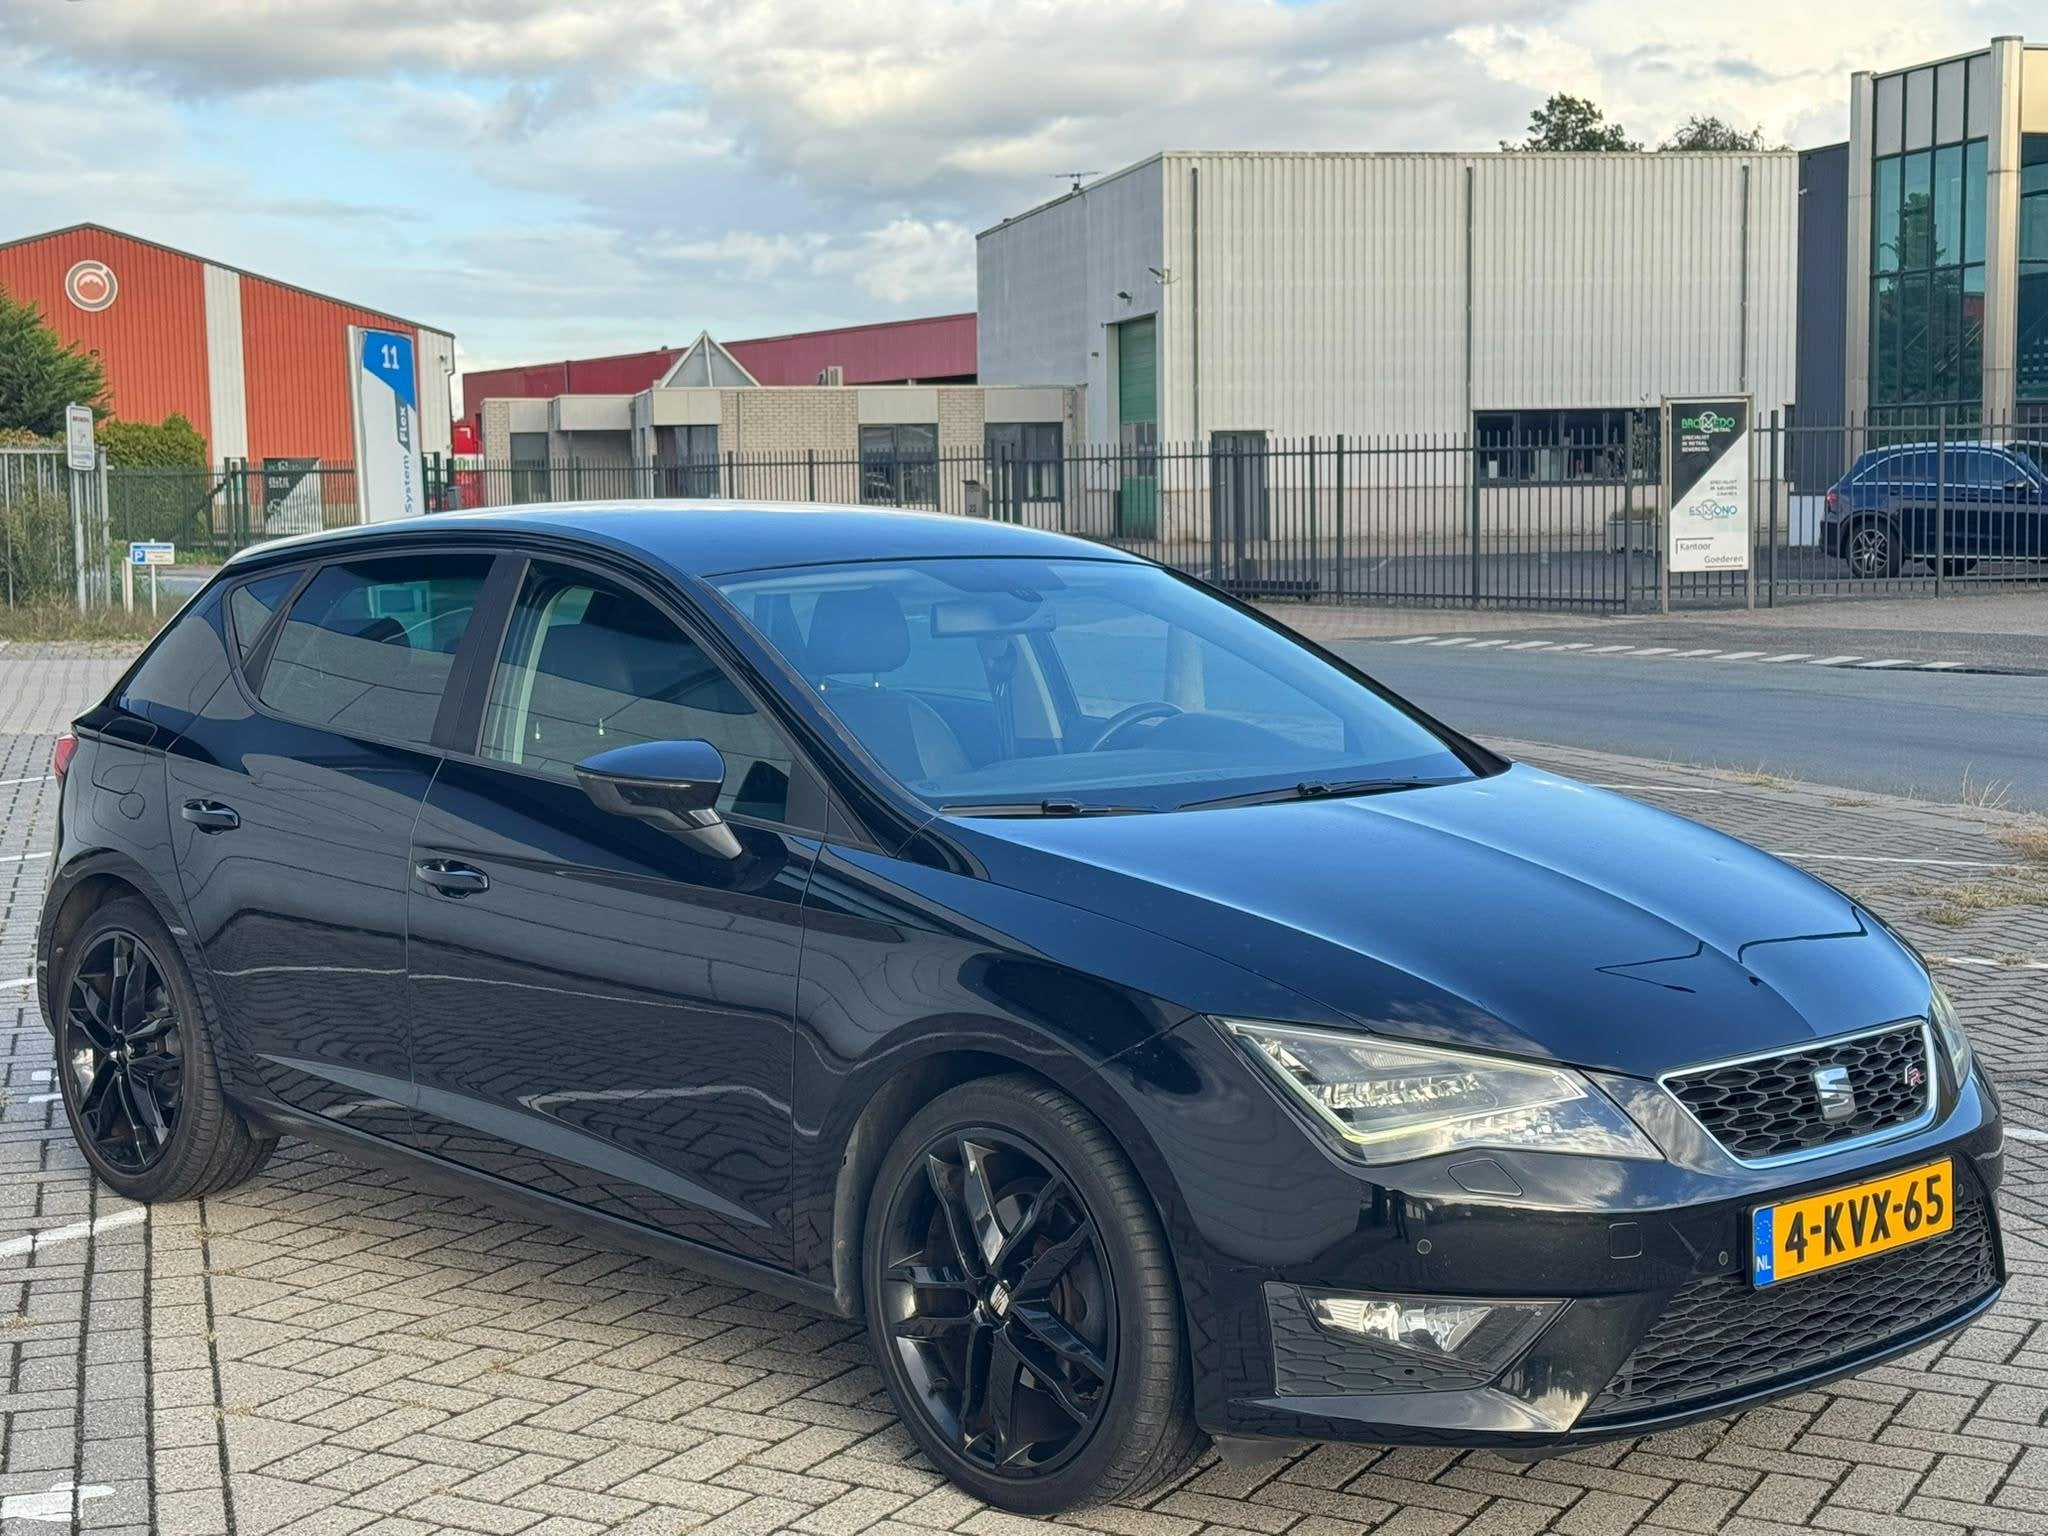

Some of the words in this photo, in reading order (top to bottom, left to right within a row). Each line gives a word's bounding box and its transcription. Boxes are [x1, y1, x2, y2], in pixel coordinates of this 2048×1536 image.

[381, 344, 400, 370] 11
[399, 406, 408, 442] Flex
[403, 454, 413, 513] System
[1680, 543, 1711, 551] Kantoor
[1704, 555, 1744, 563] Goederen
[1785, 1174, 1944, 1264] 4-KVX-65
[1756, 1254, 1772, 1272] NL
